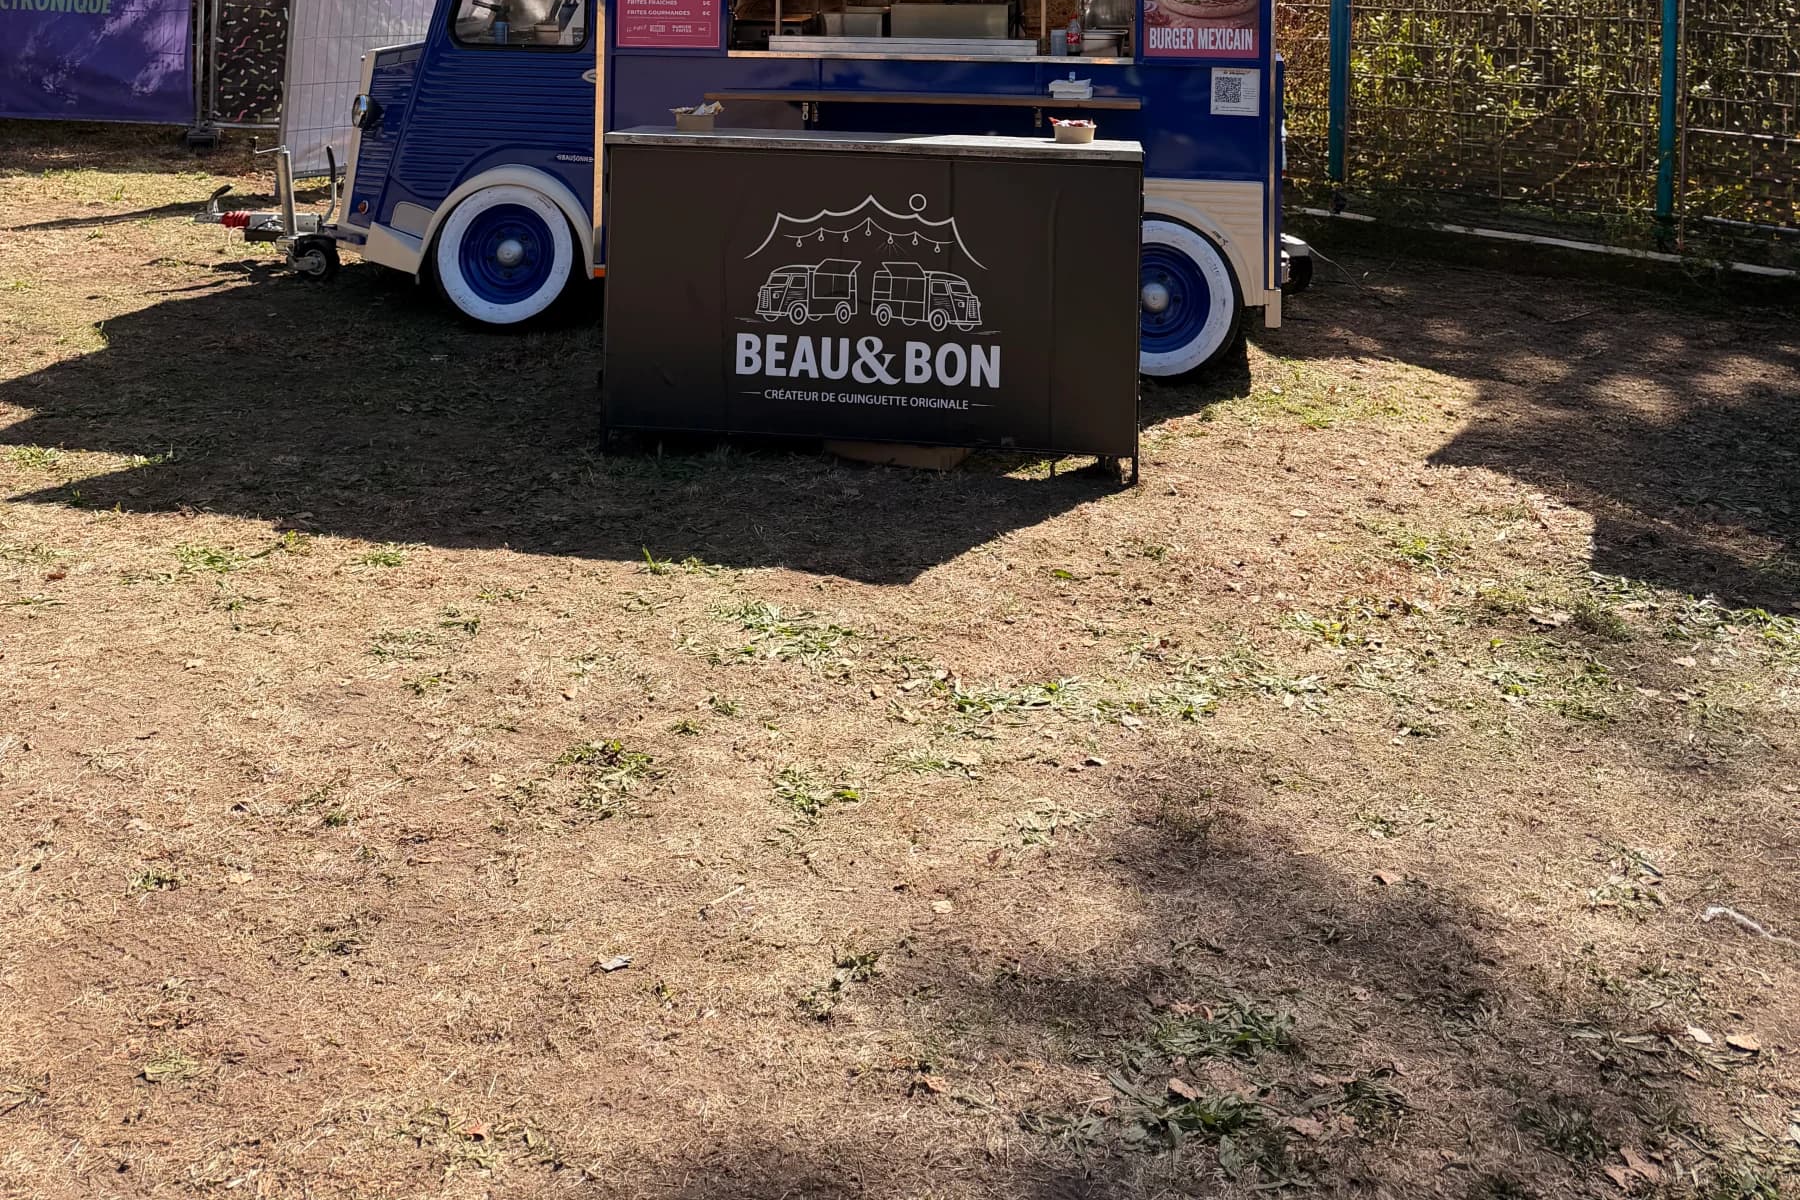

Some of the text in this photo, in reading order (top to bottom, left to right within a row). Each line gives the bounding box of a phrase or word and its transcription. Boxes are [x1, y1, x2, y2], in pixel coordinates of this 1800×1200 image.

[1149, 27, 1253, 51] BURGER MEXICAIN
[764, 388, 969, 410] CRÉATEUR DE GUINGUETTE ORIGINALE
